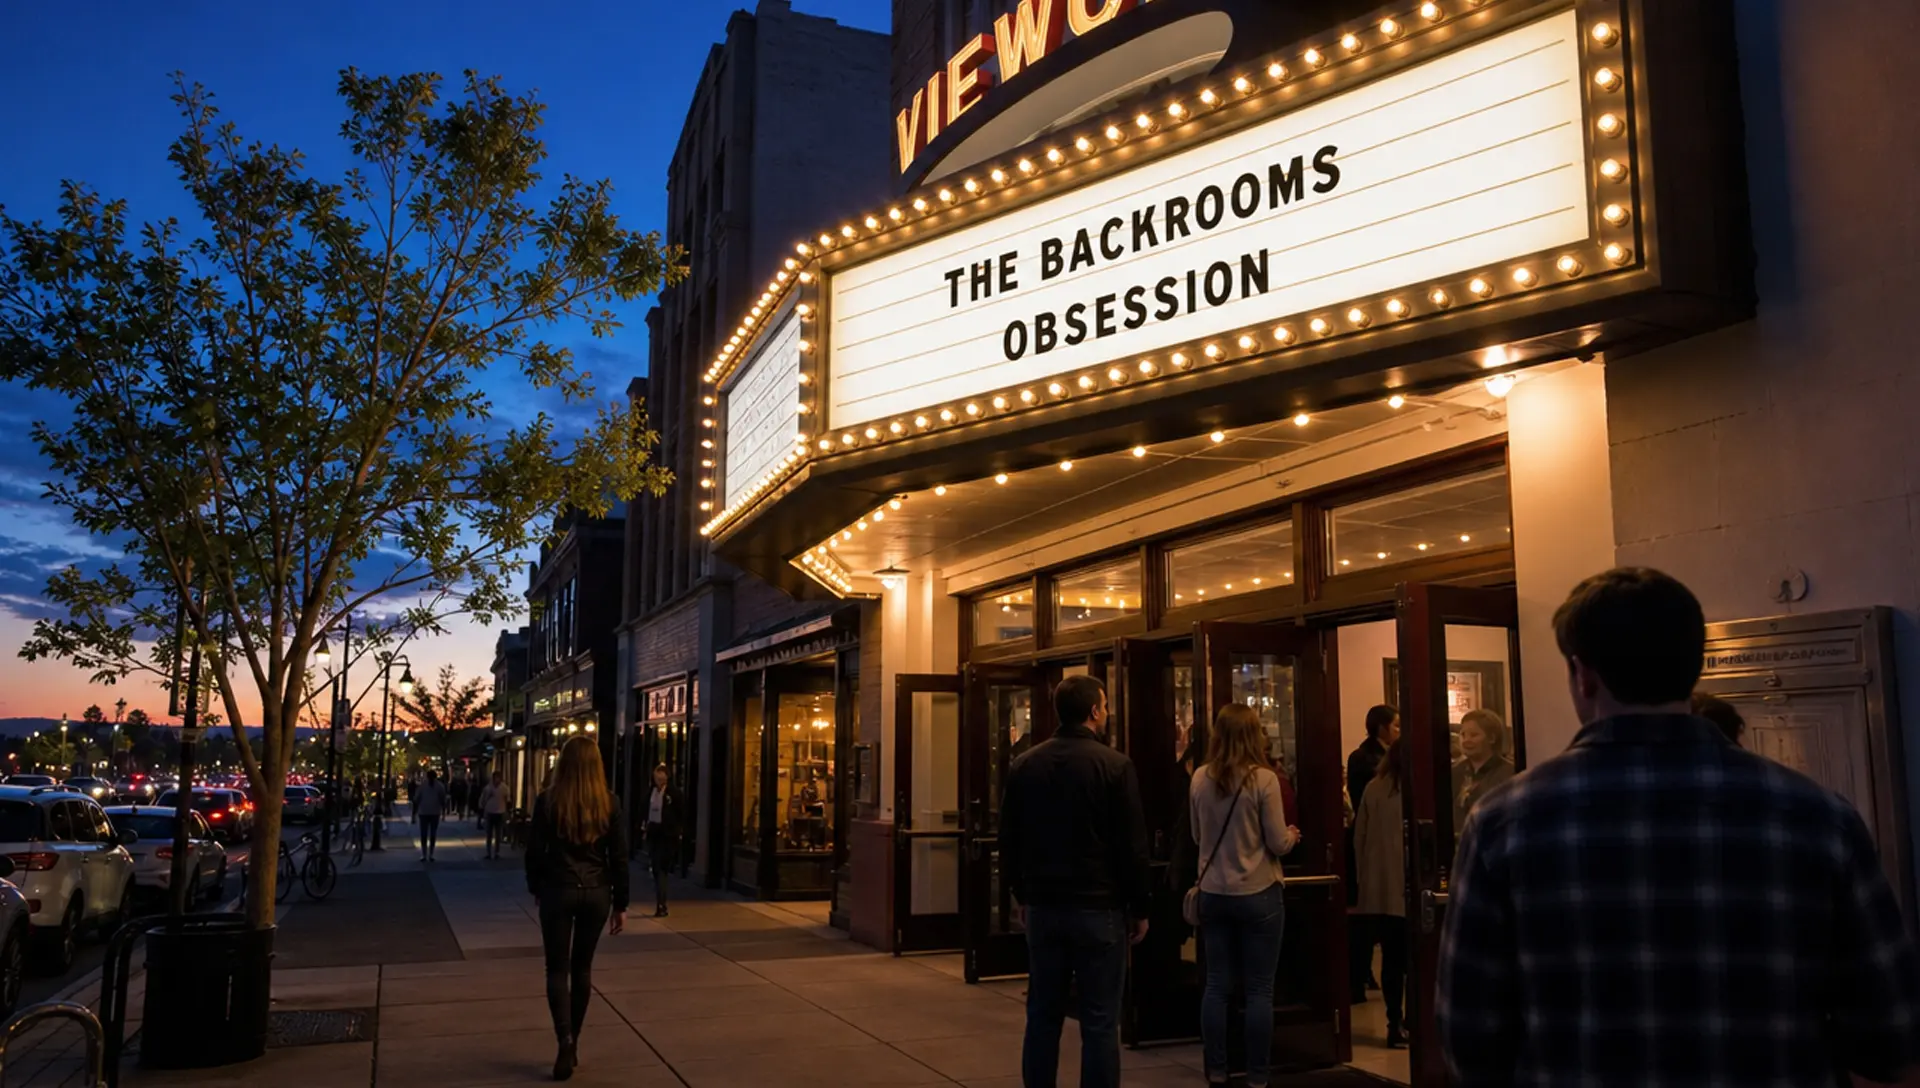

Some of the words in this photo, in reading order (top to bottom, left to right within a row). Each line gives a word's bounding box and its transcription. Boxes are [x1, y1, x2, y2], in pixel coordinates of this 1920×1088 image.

[944, 250, 1019, 308] THE
[1040, 144, 1341, 281] BACKROOMS
[1003, 248, 1269, 362] OBSESSION
